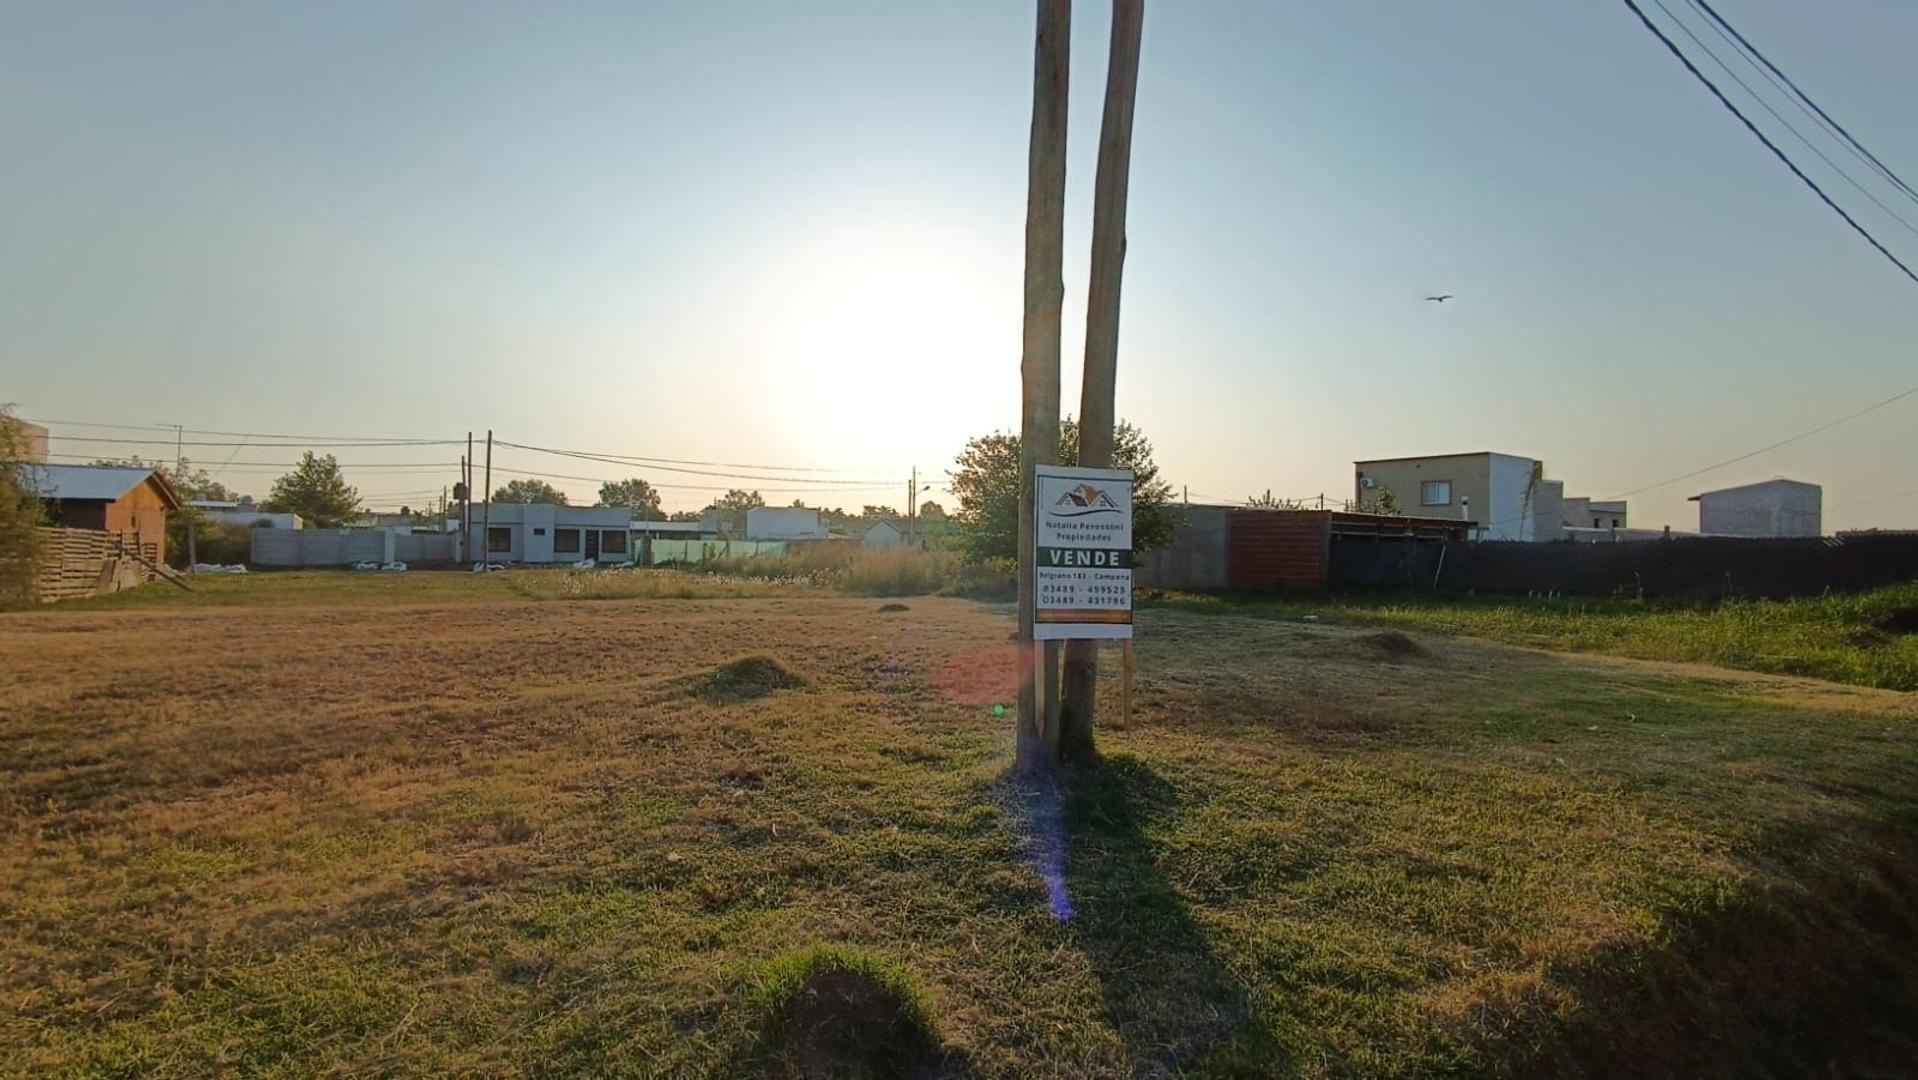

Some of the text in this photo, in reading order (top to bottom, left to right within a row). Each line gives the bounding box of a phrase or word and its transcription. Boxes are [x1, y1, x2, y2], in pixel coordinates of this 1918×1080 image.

[1056, 533, 1111, 542] Propiedades
[1050, 549, 1119, 566] VENDE
[1094, 573, 1131, 581] Campana
